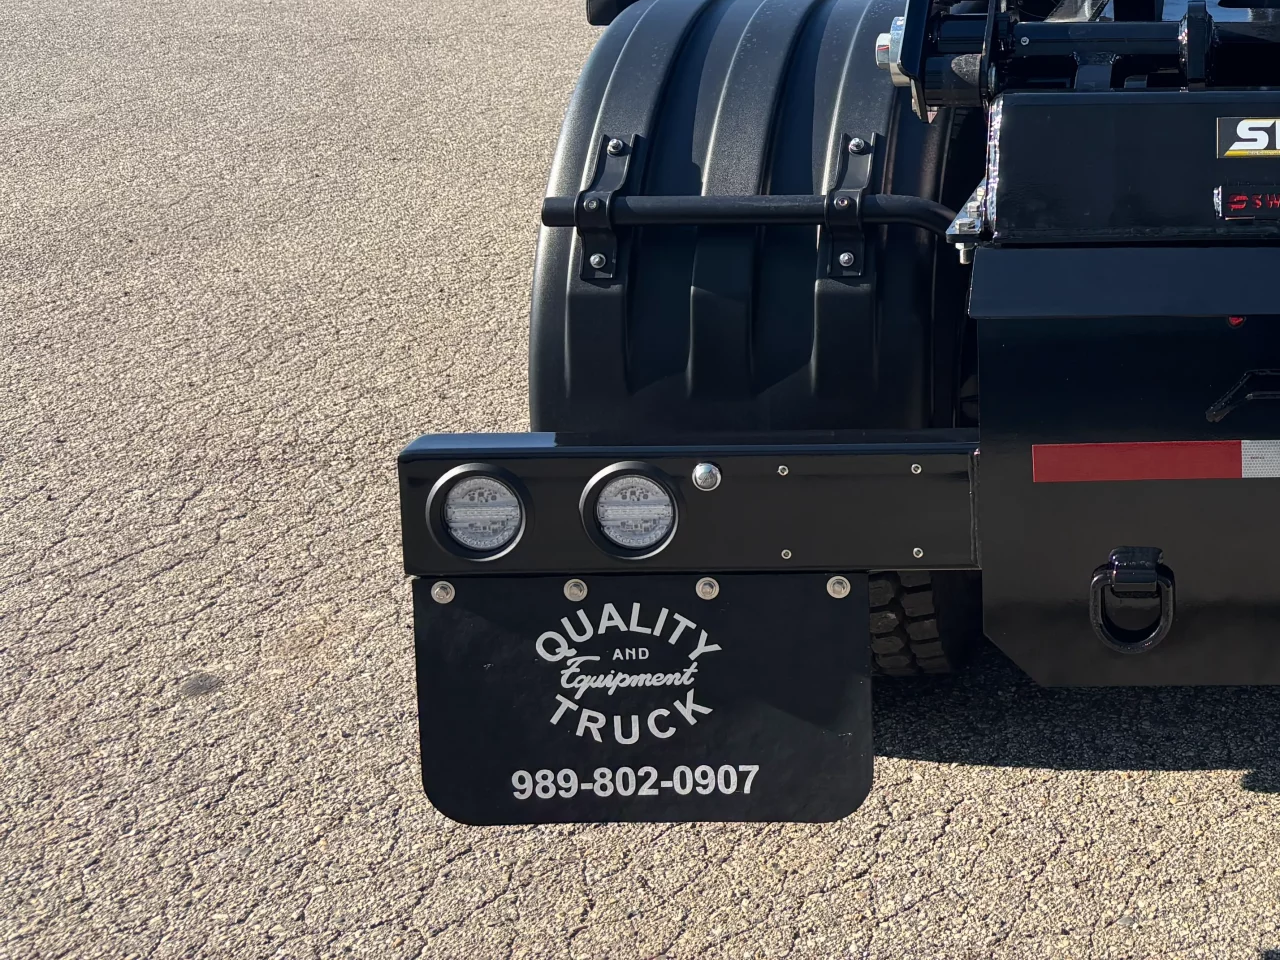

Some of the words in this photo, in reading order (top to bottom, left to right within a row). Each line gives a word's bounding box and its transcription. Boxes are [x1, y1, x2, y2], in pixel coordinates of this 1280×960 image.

[535, 602, 722, 662] QUALITY
[612, 647, 650, 661] AND
[560, 655, 699, 700] Equipment
[549, 688, 713, 745] TRUCK
[511, 764, 760, 800] 989-802-0907
